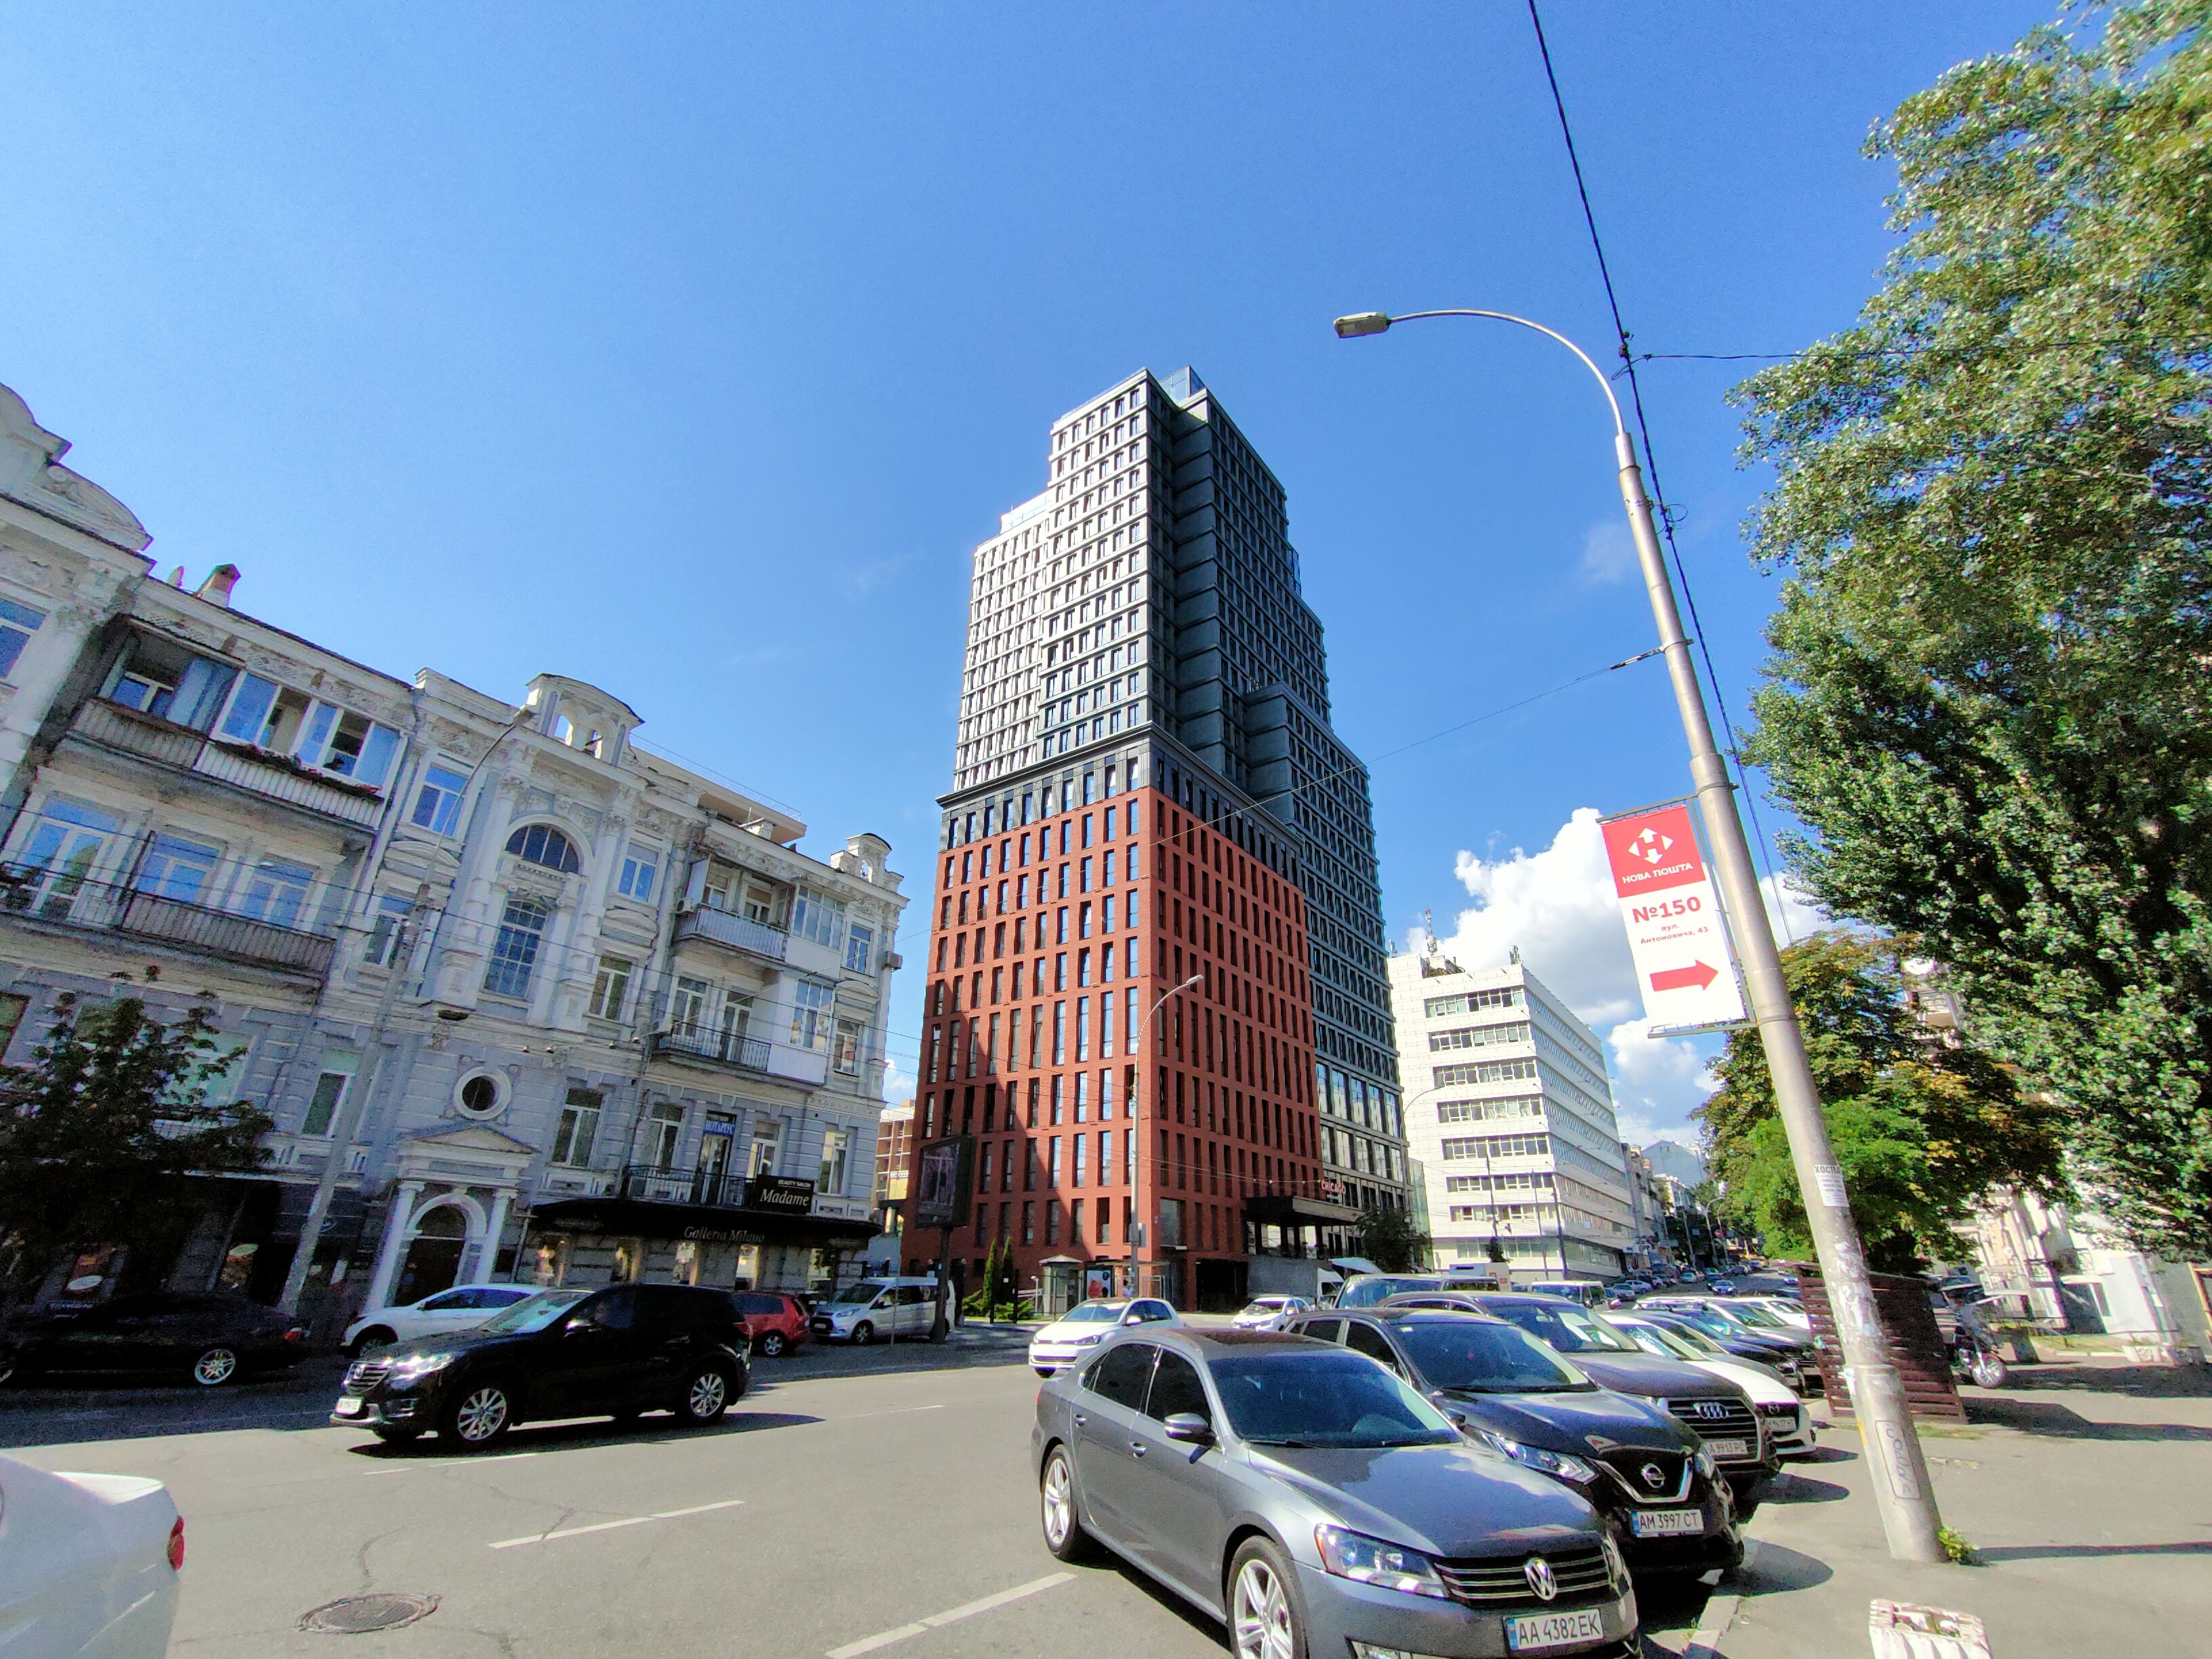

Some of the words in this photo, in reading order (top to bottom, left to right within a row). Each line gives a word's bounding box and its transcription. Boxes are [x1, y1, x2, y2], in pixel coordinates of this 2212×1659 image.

[1622, 872, 1652, 884] НОВА
[1653, 863, 1694, 877] ПОШТА
[1632, 897, 1701, 923] №150
[1661, 924, 1680, 932] вул.
[1641, 930, 1695, 944] Антоновича,
[1322, 1180, 1346, 1195] CHICAGO
[759, 1189, 809, 1206] Madame
[684, 1226, 727, 1241] Galleria
[729, 1229, 764, 1242] Milano
